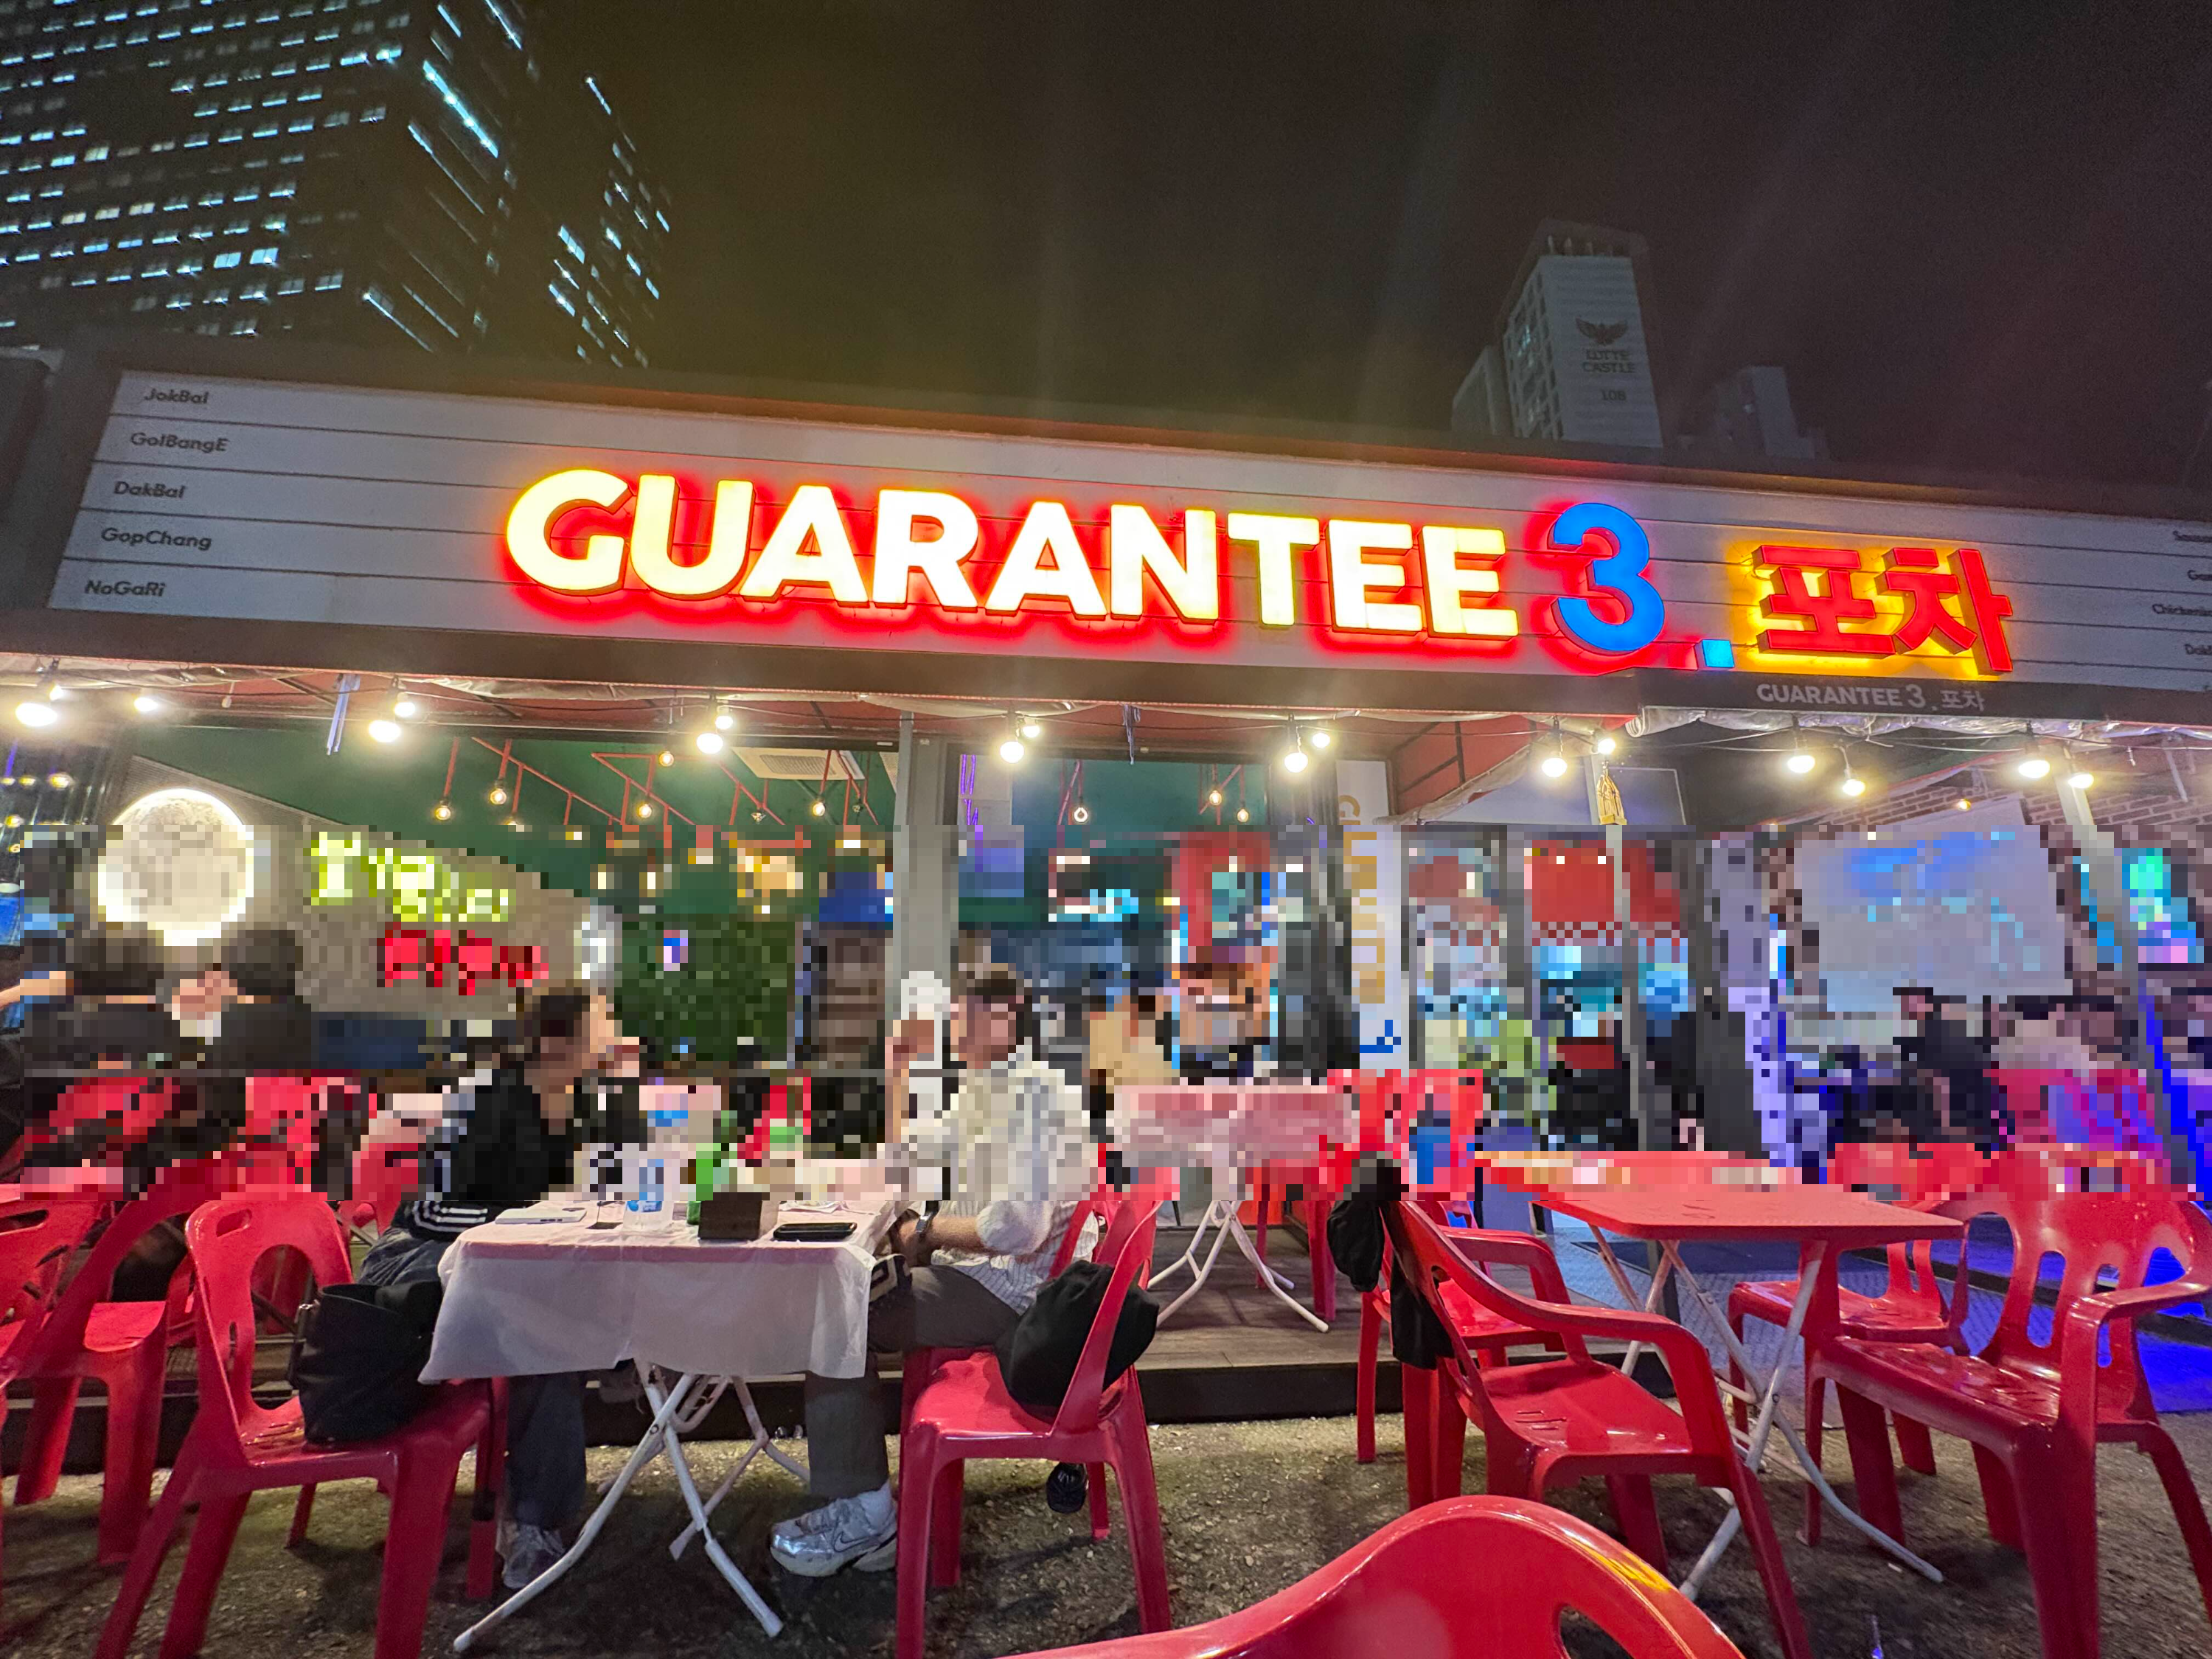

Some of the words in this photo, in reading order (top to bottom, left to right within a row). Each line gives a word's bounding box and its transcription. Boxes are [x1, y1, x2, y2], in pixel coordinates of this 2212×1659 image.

[1582, 362, 1635, 374] CASTLE
[131, 432, 228, 453] GolBangE
[101, 527, 212, 551] GopChang
[506, 469, 1519, 640] GUARANTEE
[1752, 544, 2013, 674] 포차
[85, 580, 165, 598] NoGaRi
[1756, 683, 1903, 706] GUARANTEE
[1940, 689, 1985, 712] 포차
